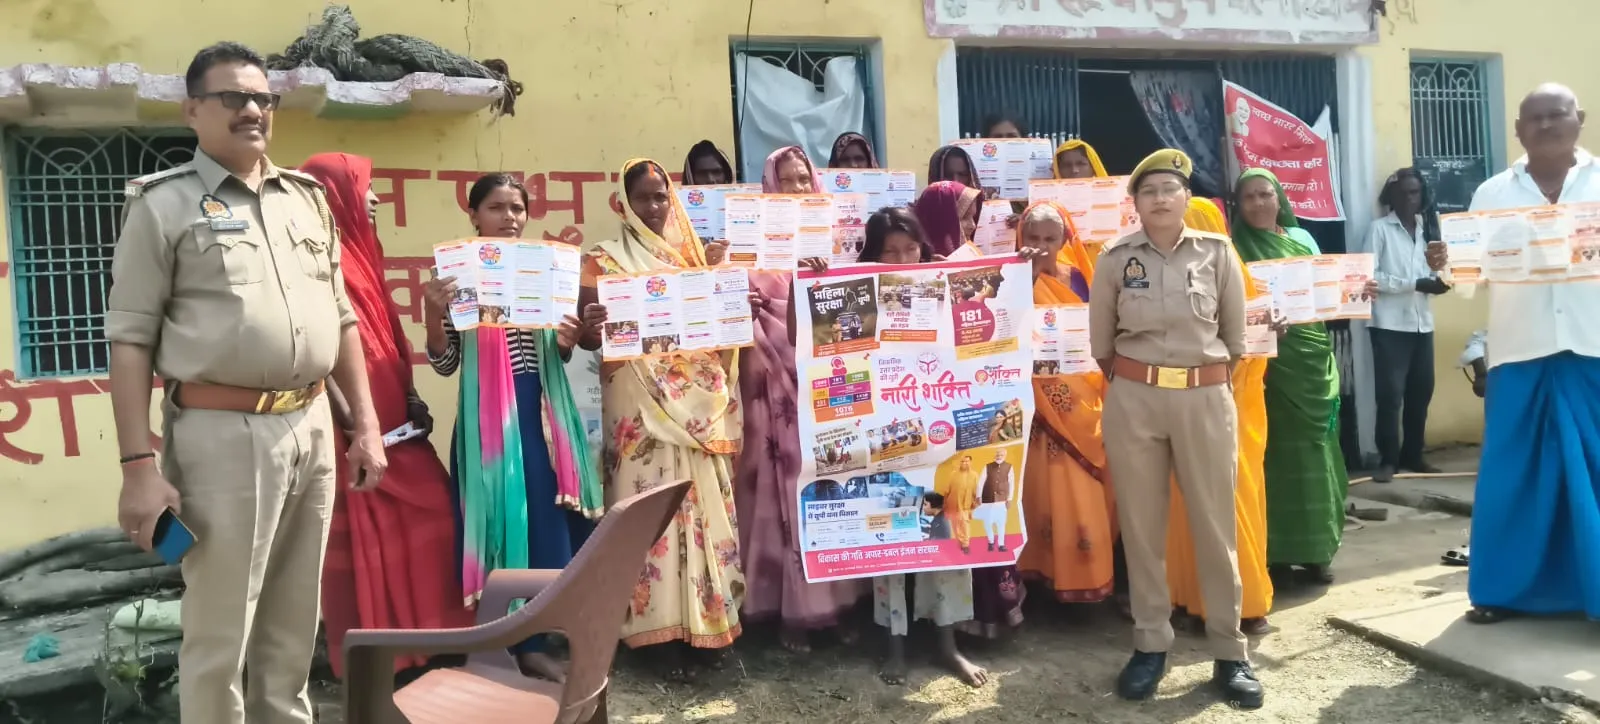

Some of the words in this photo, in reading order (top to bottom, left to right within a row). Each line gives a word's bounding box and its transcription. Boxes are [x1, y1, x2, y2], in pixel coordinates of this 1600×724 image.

[813, 287, 845, 300] महिला
[815, 299, 844, 314] सुरक्षा
[960, 309, 982, 322] 181
[880, 374, 921, 412] नारी
[922, 370, 972, 411] शक्ति
[818, 553, 840, 564] विकास
